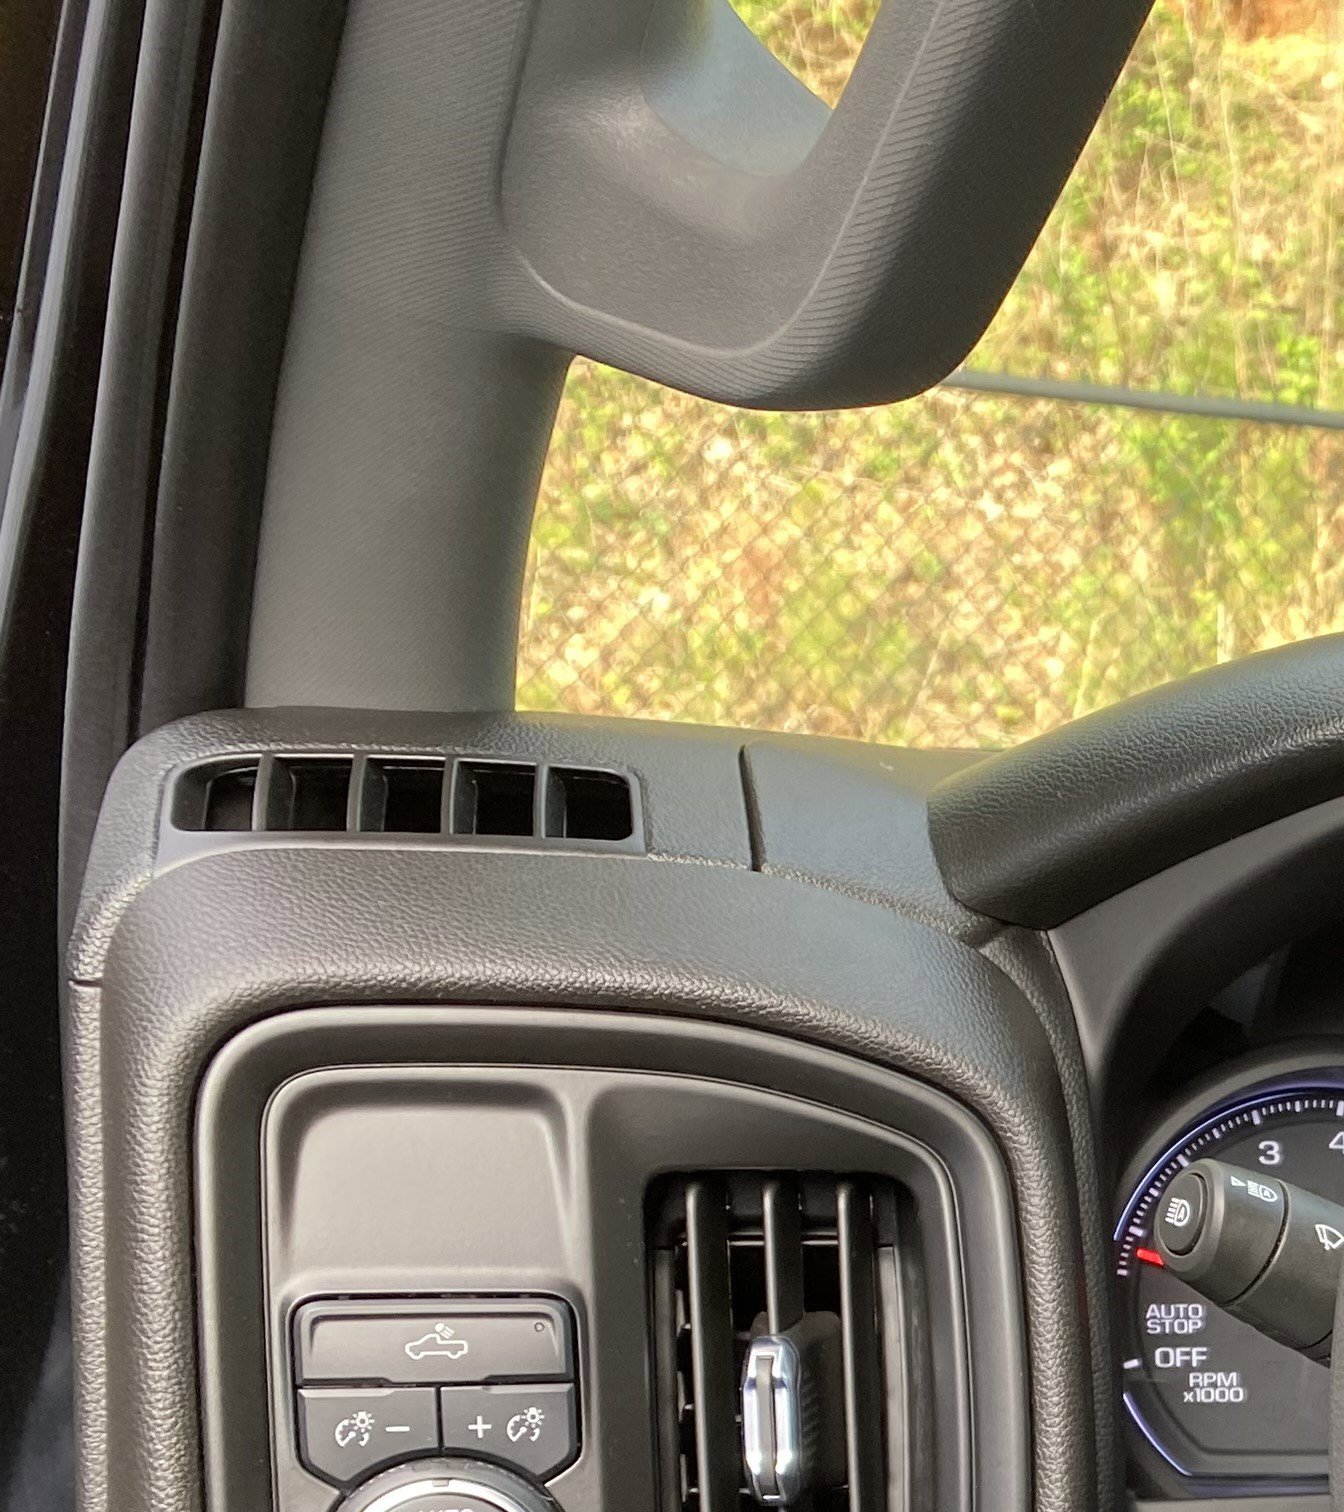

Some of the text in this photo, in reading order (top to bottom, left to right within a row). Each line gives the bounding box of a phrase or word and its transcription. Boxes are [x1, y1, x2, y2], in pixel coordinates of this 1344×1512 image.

[1258, 1141, 1282, 1165] 3
[1146, 1304, 1203, 1319] AUTO
[1147, 1319, 1202, 1334] STOP
[1154, 1347, 1208, 1368] OFF
[1189, 1372, 1238, 1388] RPM
[1183, 1387, 1244, 1403] x1000
